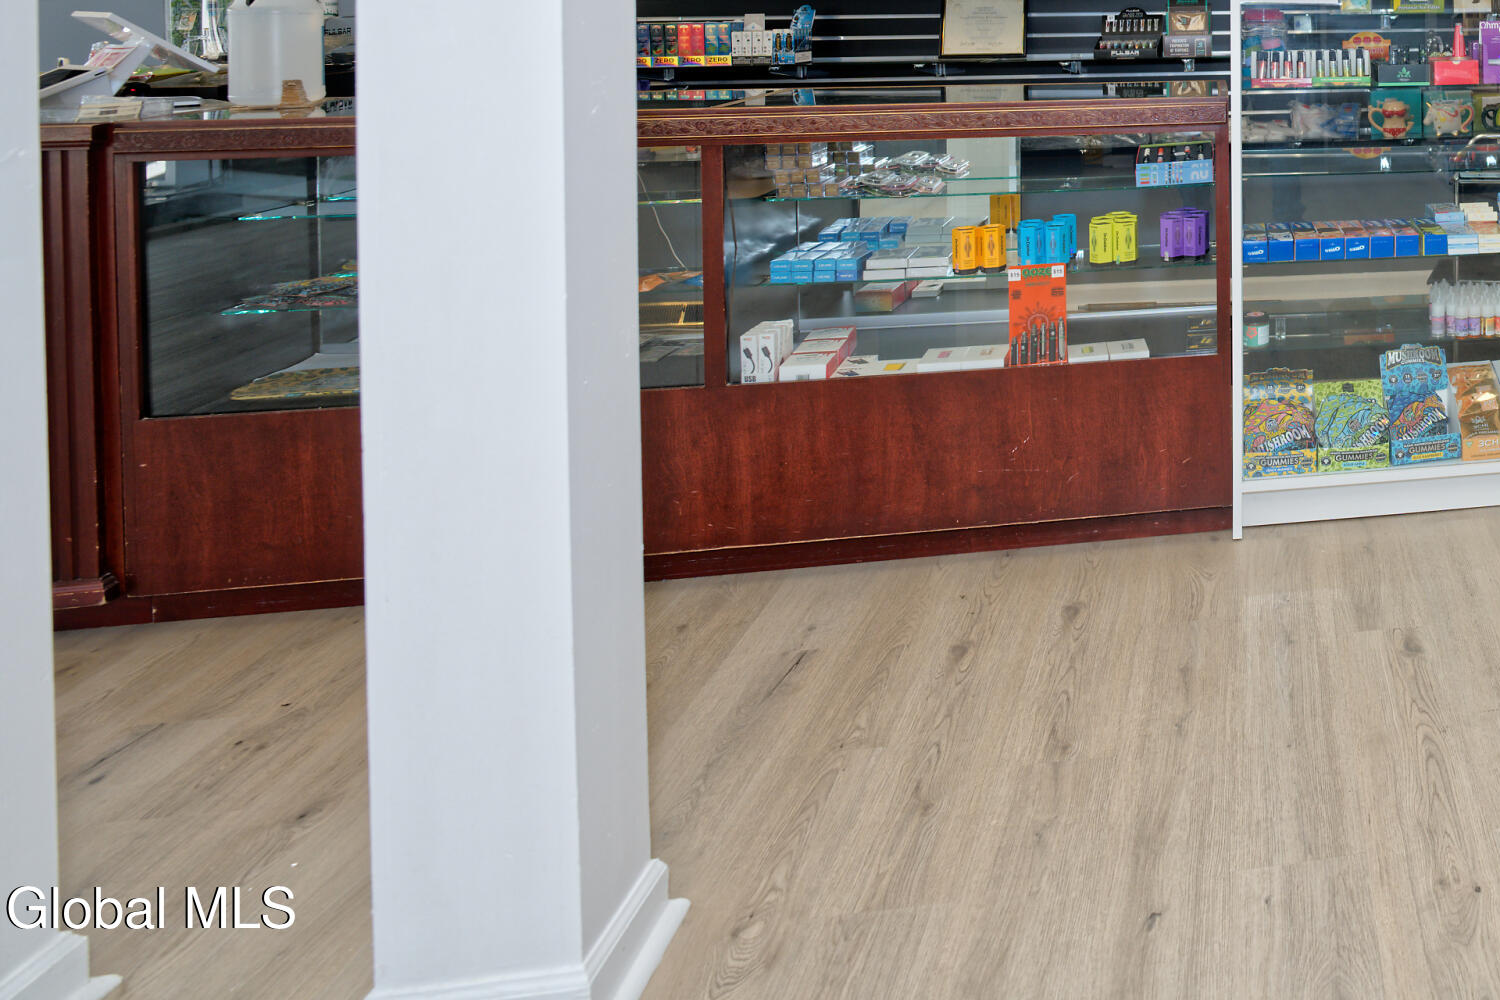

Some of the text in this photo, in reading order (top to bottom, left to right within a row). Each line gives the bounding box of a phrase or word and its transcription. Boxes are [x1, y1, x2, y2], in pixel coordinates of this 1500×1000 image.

[1388, 347, 1440, 366] MUSHROOM
[1409, 443, 1446, 454] GUMMIES
[1260, 457, 1299, 466] GUMMIES
[1335, 453, 1373, 461] GUMMIES
